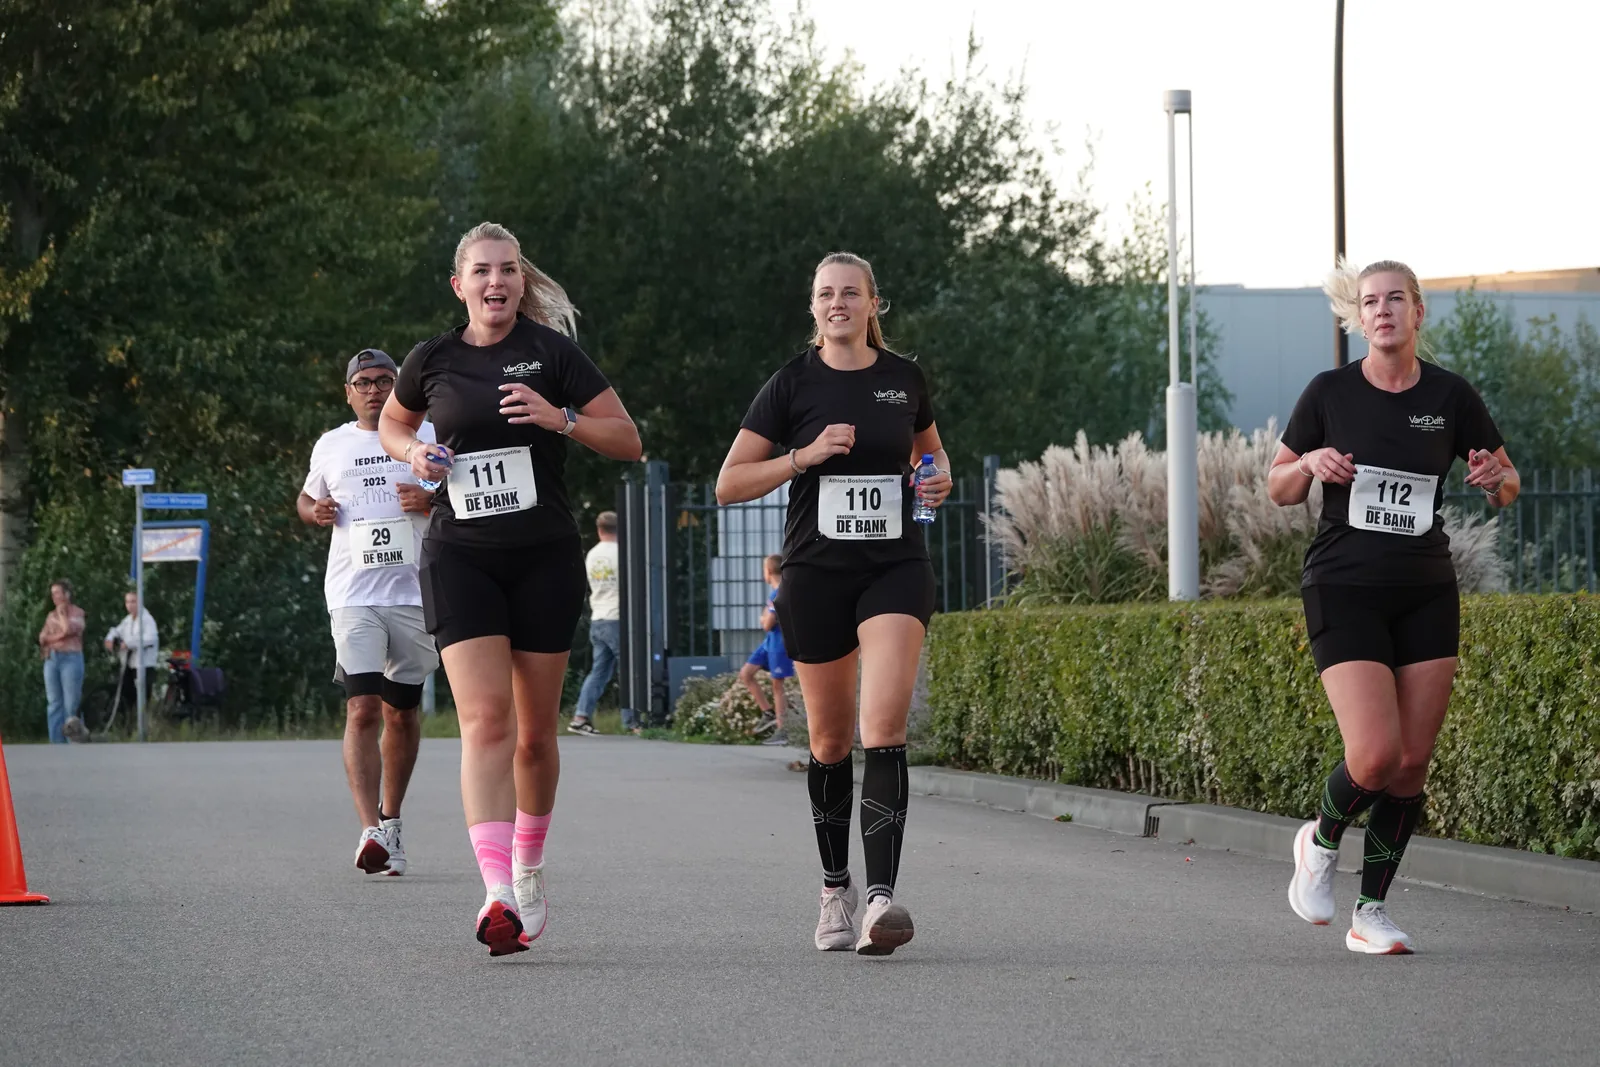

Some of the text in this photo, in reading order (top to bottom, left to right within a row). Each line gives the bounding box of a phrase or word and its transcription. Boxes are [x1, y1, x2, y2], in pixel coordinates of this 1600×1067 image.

[354, 454, 392, 467] IEDEMA
[469, 449, 522, 461] Bosloopcompetitie
[386, 463, 408, 473] RUN
[469, 460, 506, 488] 111
[1363, 468, 1431, 483] Athlos Bosloopcompetitie
[362, 476, 387, 487] 2025
[847, 477, 895, 485] Bosloopcompetitie
[845, 487, 882, 511] 110
[1377, 480, 1413, 506] 112
[465, 490, 520, 512] DE BANK
[836, 519, 887, 533] DE BANK
[1365, 510, 1416, 529] DE BANK
[371, 527, 391, 547] 29
[363, 550, 404, 565] DE BANK
